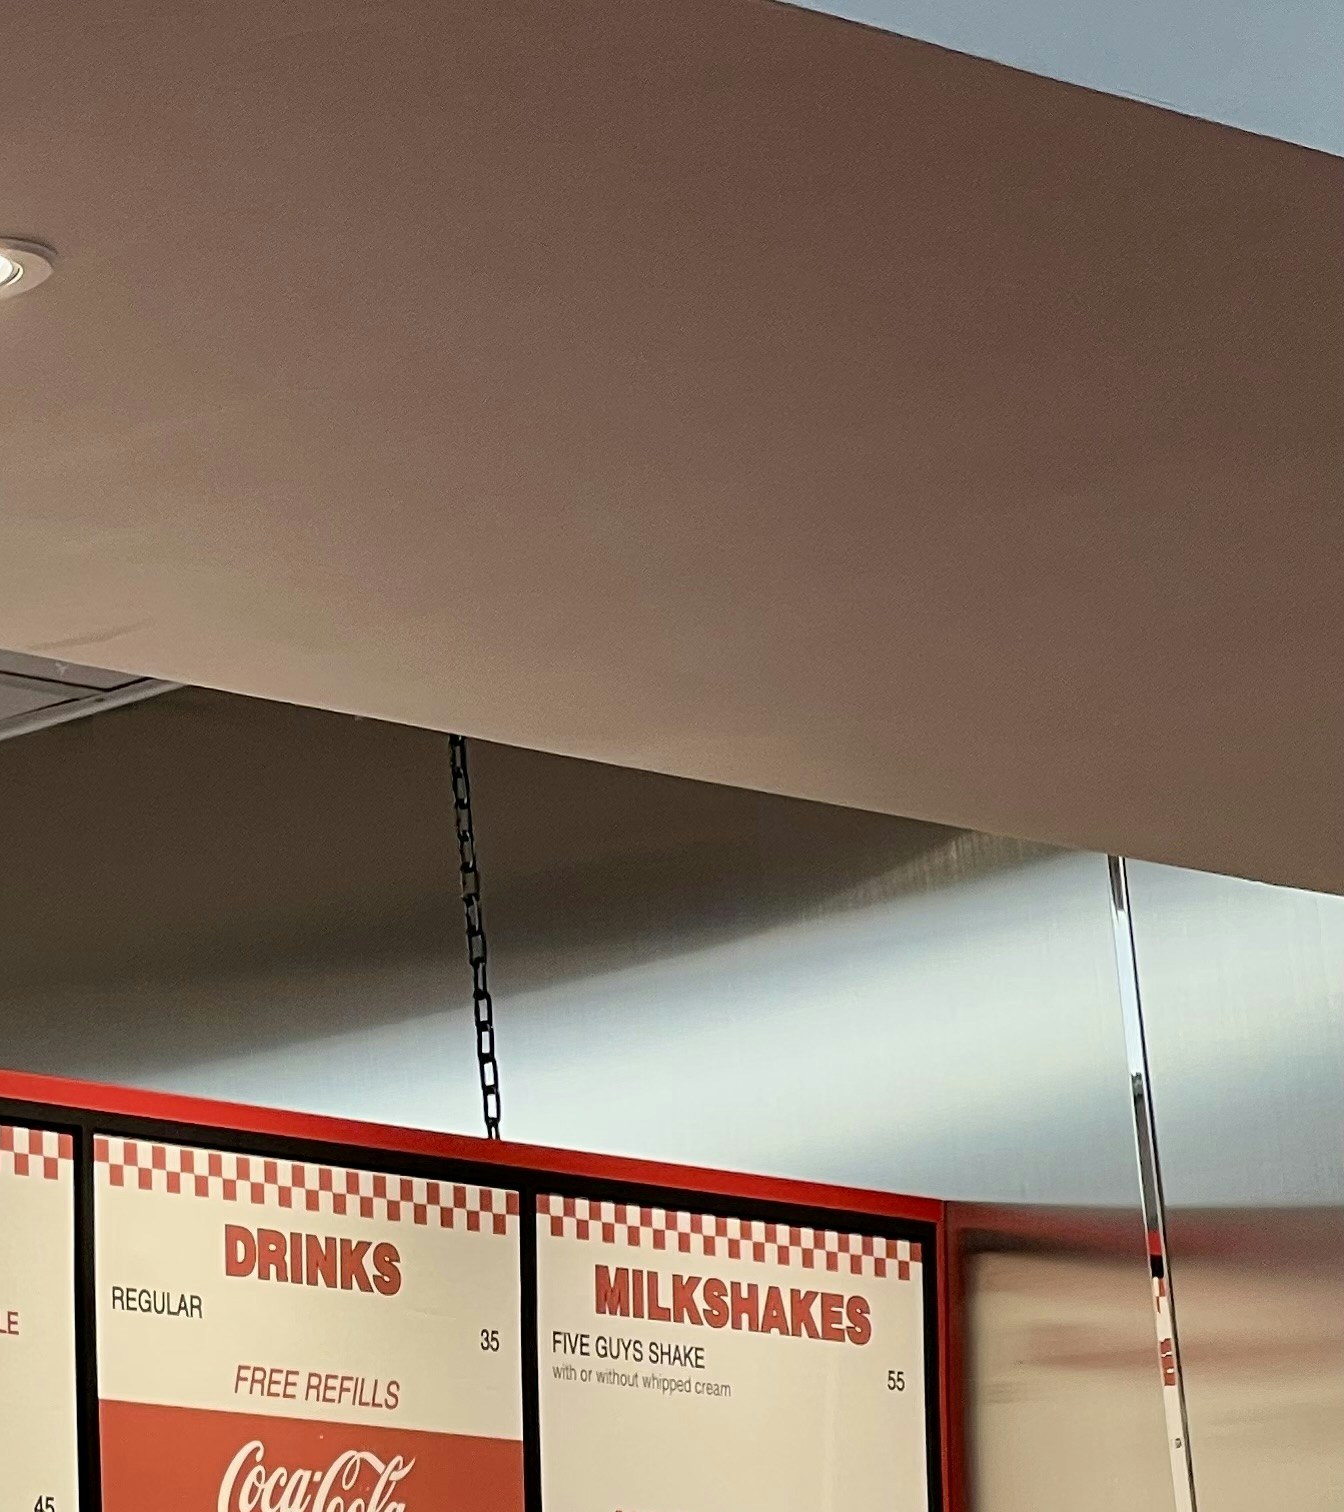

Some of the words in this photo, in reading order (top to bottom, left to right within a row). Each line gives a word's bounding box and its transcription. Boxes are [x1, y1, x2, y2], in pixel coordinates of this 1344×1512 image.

[225, 1224, 401, 1296] DRINKS
[112, 1286, 202, 1318] REGULAR
[595, 1264, 871, 1345] MILKSHAKES
[481, 1329, 499, 1351] 35
[553, 1331, 590, 1356] FIVE
[595, 1336, 643, 1362] GUYS
[649, 1342, 705, 1368] SHAKE
[235, 1365, 299, 1399] FREE
[305, 1372, 400, 1410] REFILLS
[552, 1365, 577, 1380] with
[580, 1369, 592, 1382] or
[596, 1369, 638, 1388] without
[642, 1374, 691, 1394] whipped
[695, 1382, 731, 1396] cream
[888, 1370, 905, 1391] 55
